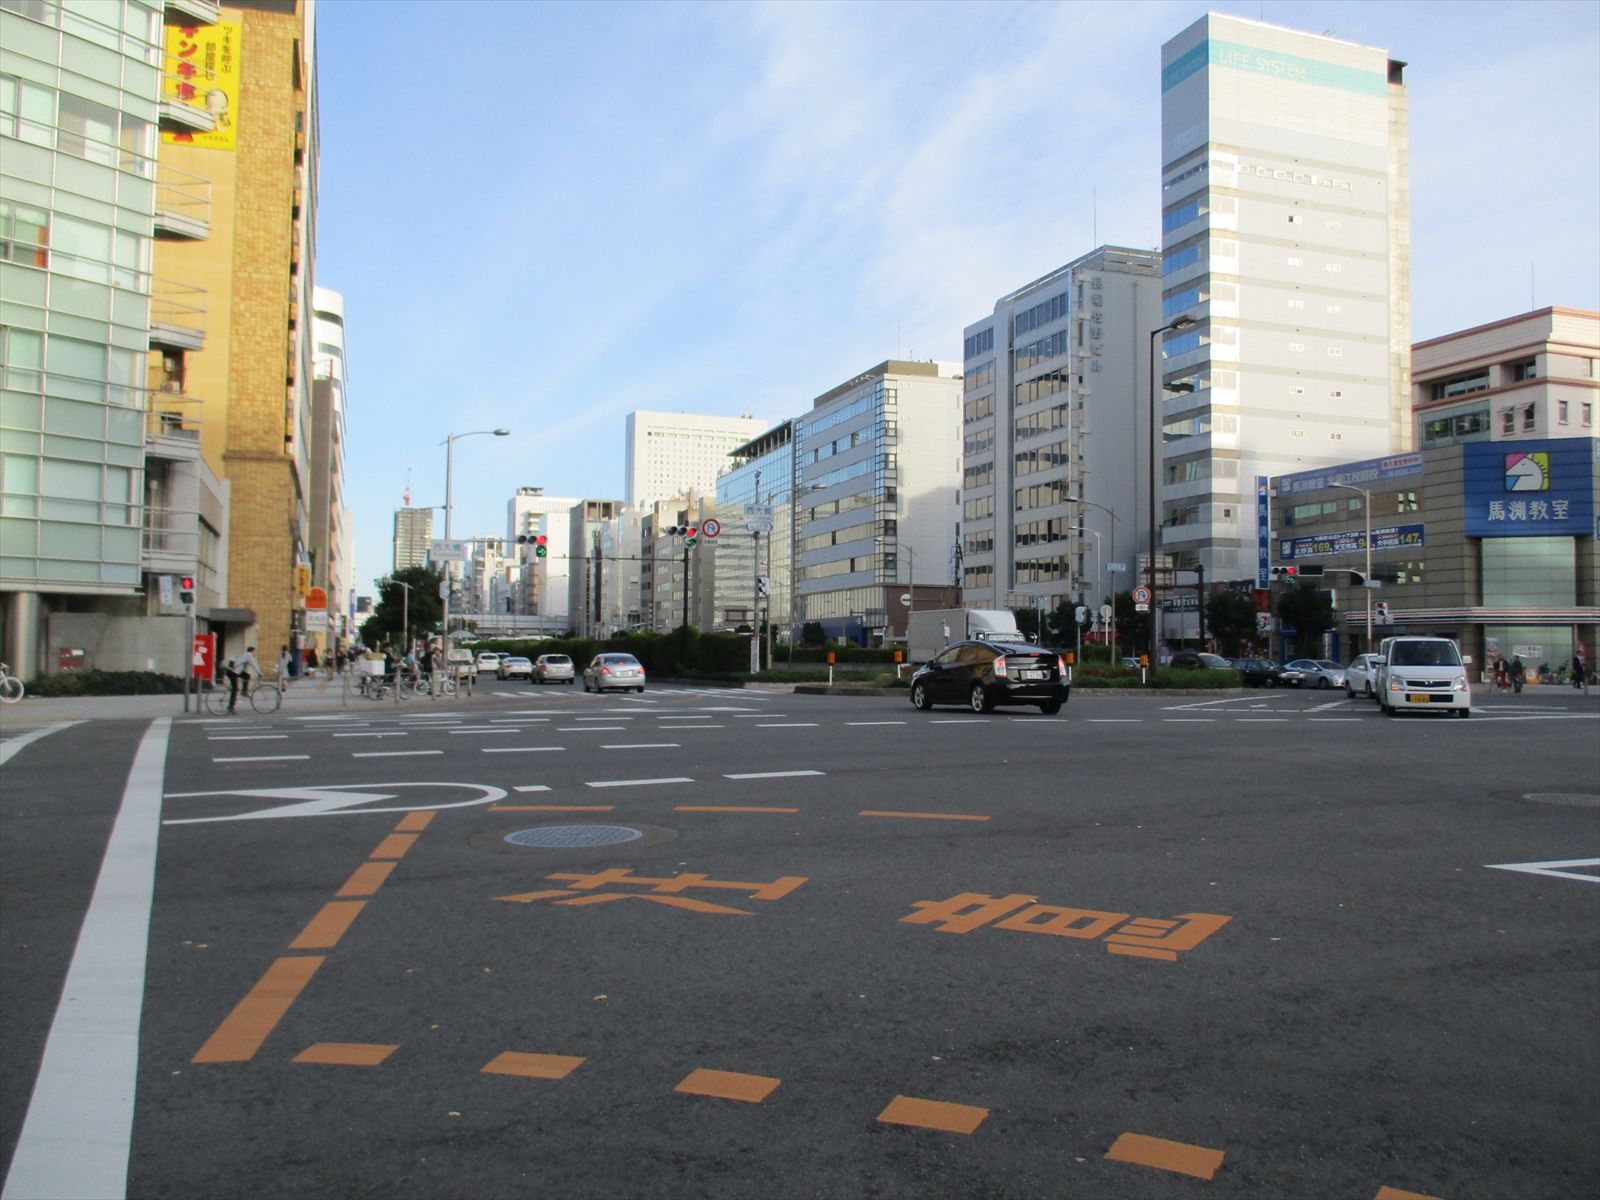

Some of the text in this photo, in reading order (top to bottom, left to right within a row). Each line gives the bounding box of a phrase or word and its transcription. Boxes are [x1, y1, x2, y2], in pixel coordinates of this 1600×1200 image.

[1218, 48, 1307, 80] LIFE SYSTEM
[1488, 499, 1570, 521] 馬渕教室
